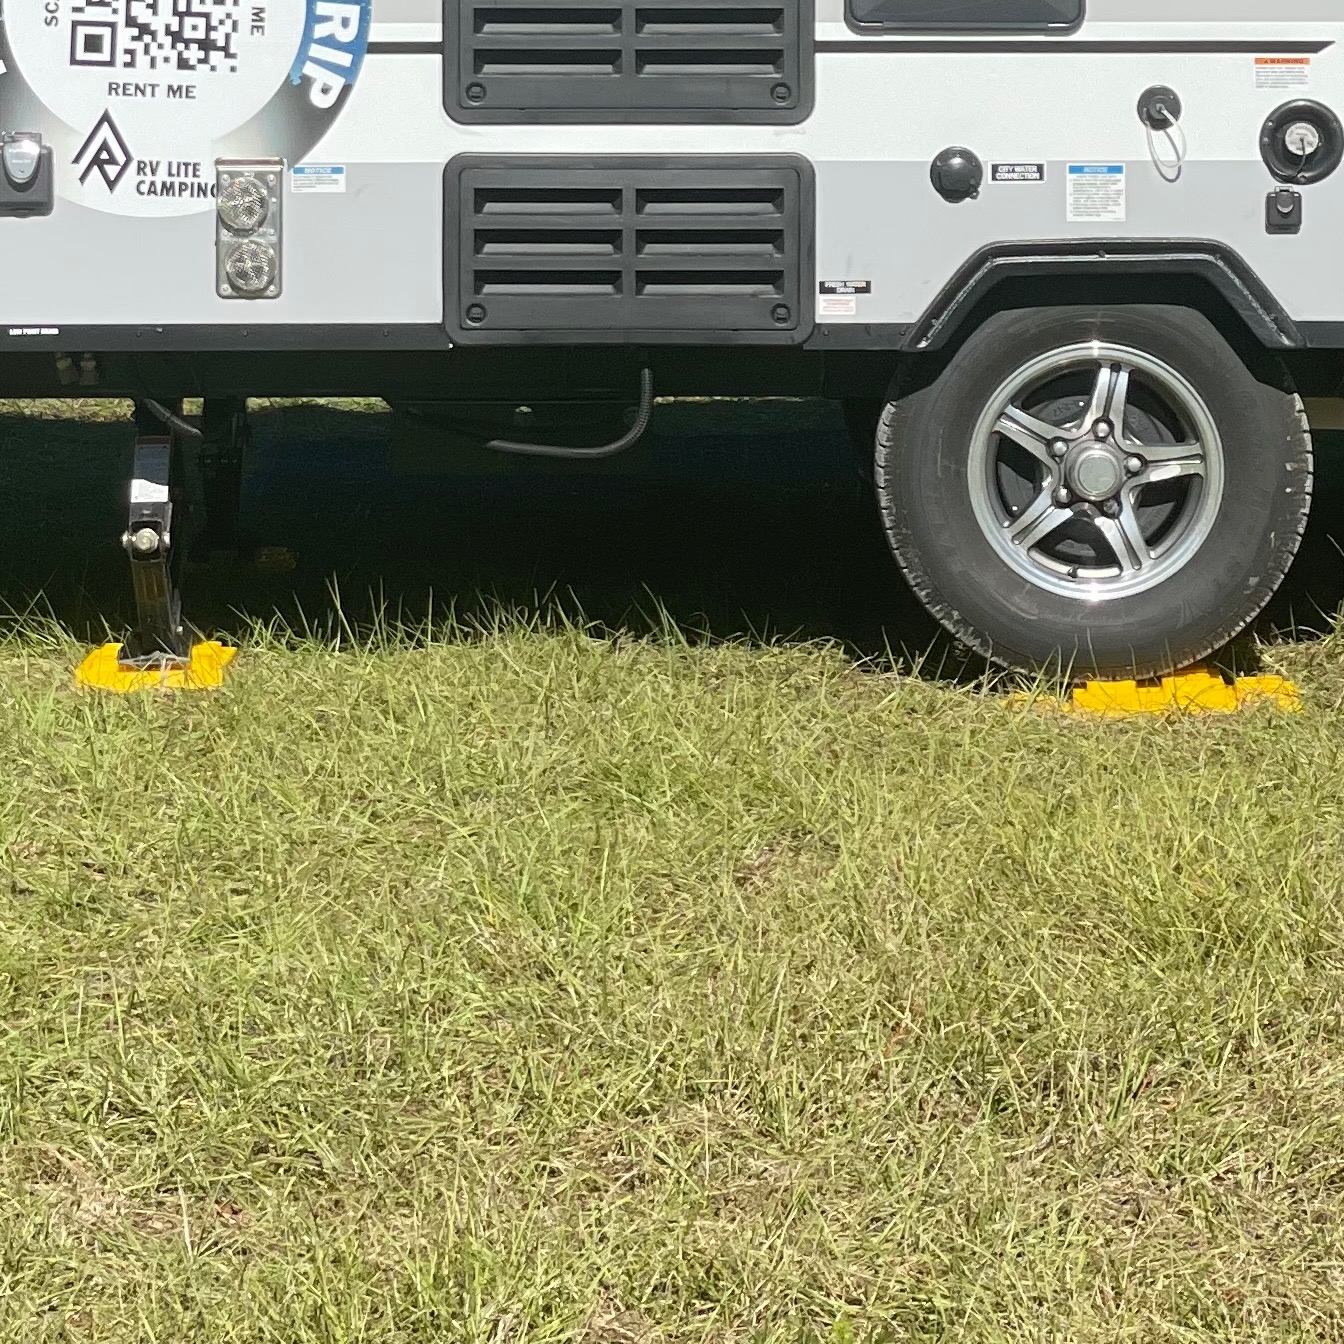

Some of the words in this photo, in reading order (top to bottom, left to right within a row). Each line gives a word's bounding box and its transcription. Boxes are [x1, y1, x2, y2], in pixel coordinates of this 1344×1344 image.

[250, 7, 266, 37] ME
[107, 82, 160, 97] RENT
[166, 84, 197, 100] ME
[136, 160, 161, 177] RV
[168, 161, 202, 178] LITE
[995, 172, 1040, 180] CONNECTION
[997, 165, 1013, 173] CITY
[1014, 165, 1038, 173] WATER
